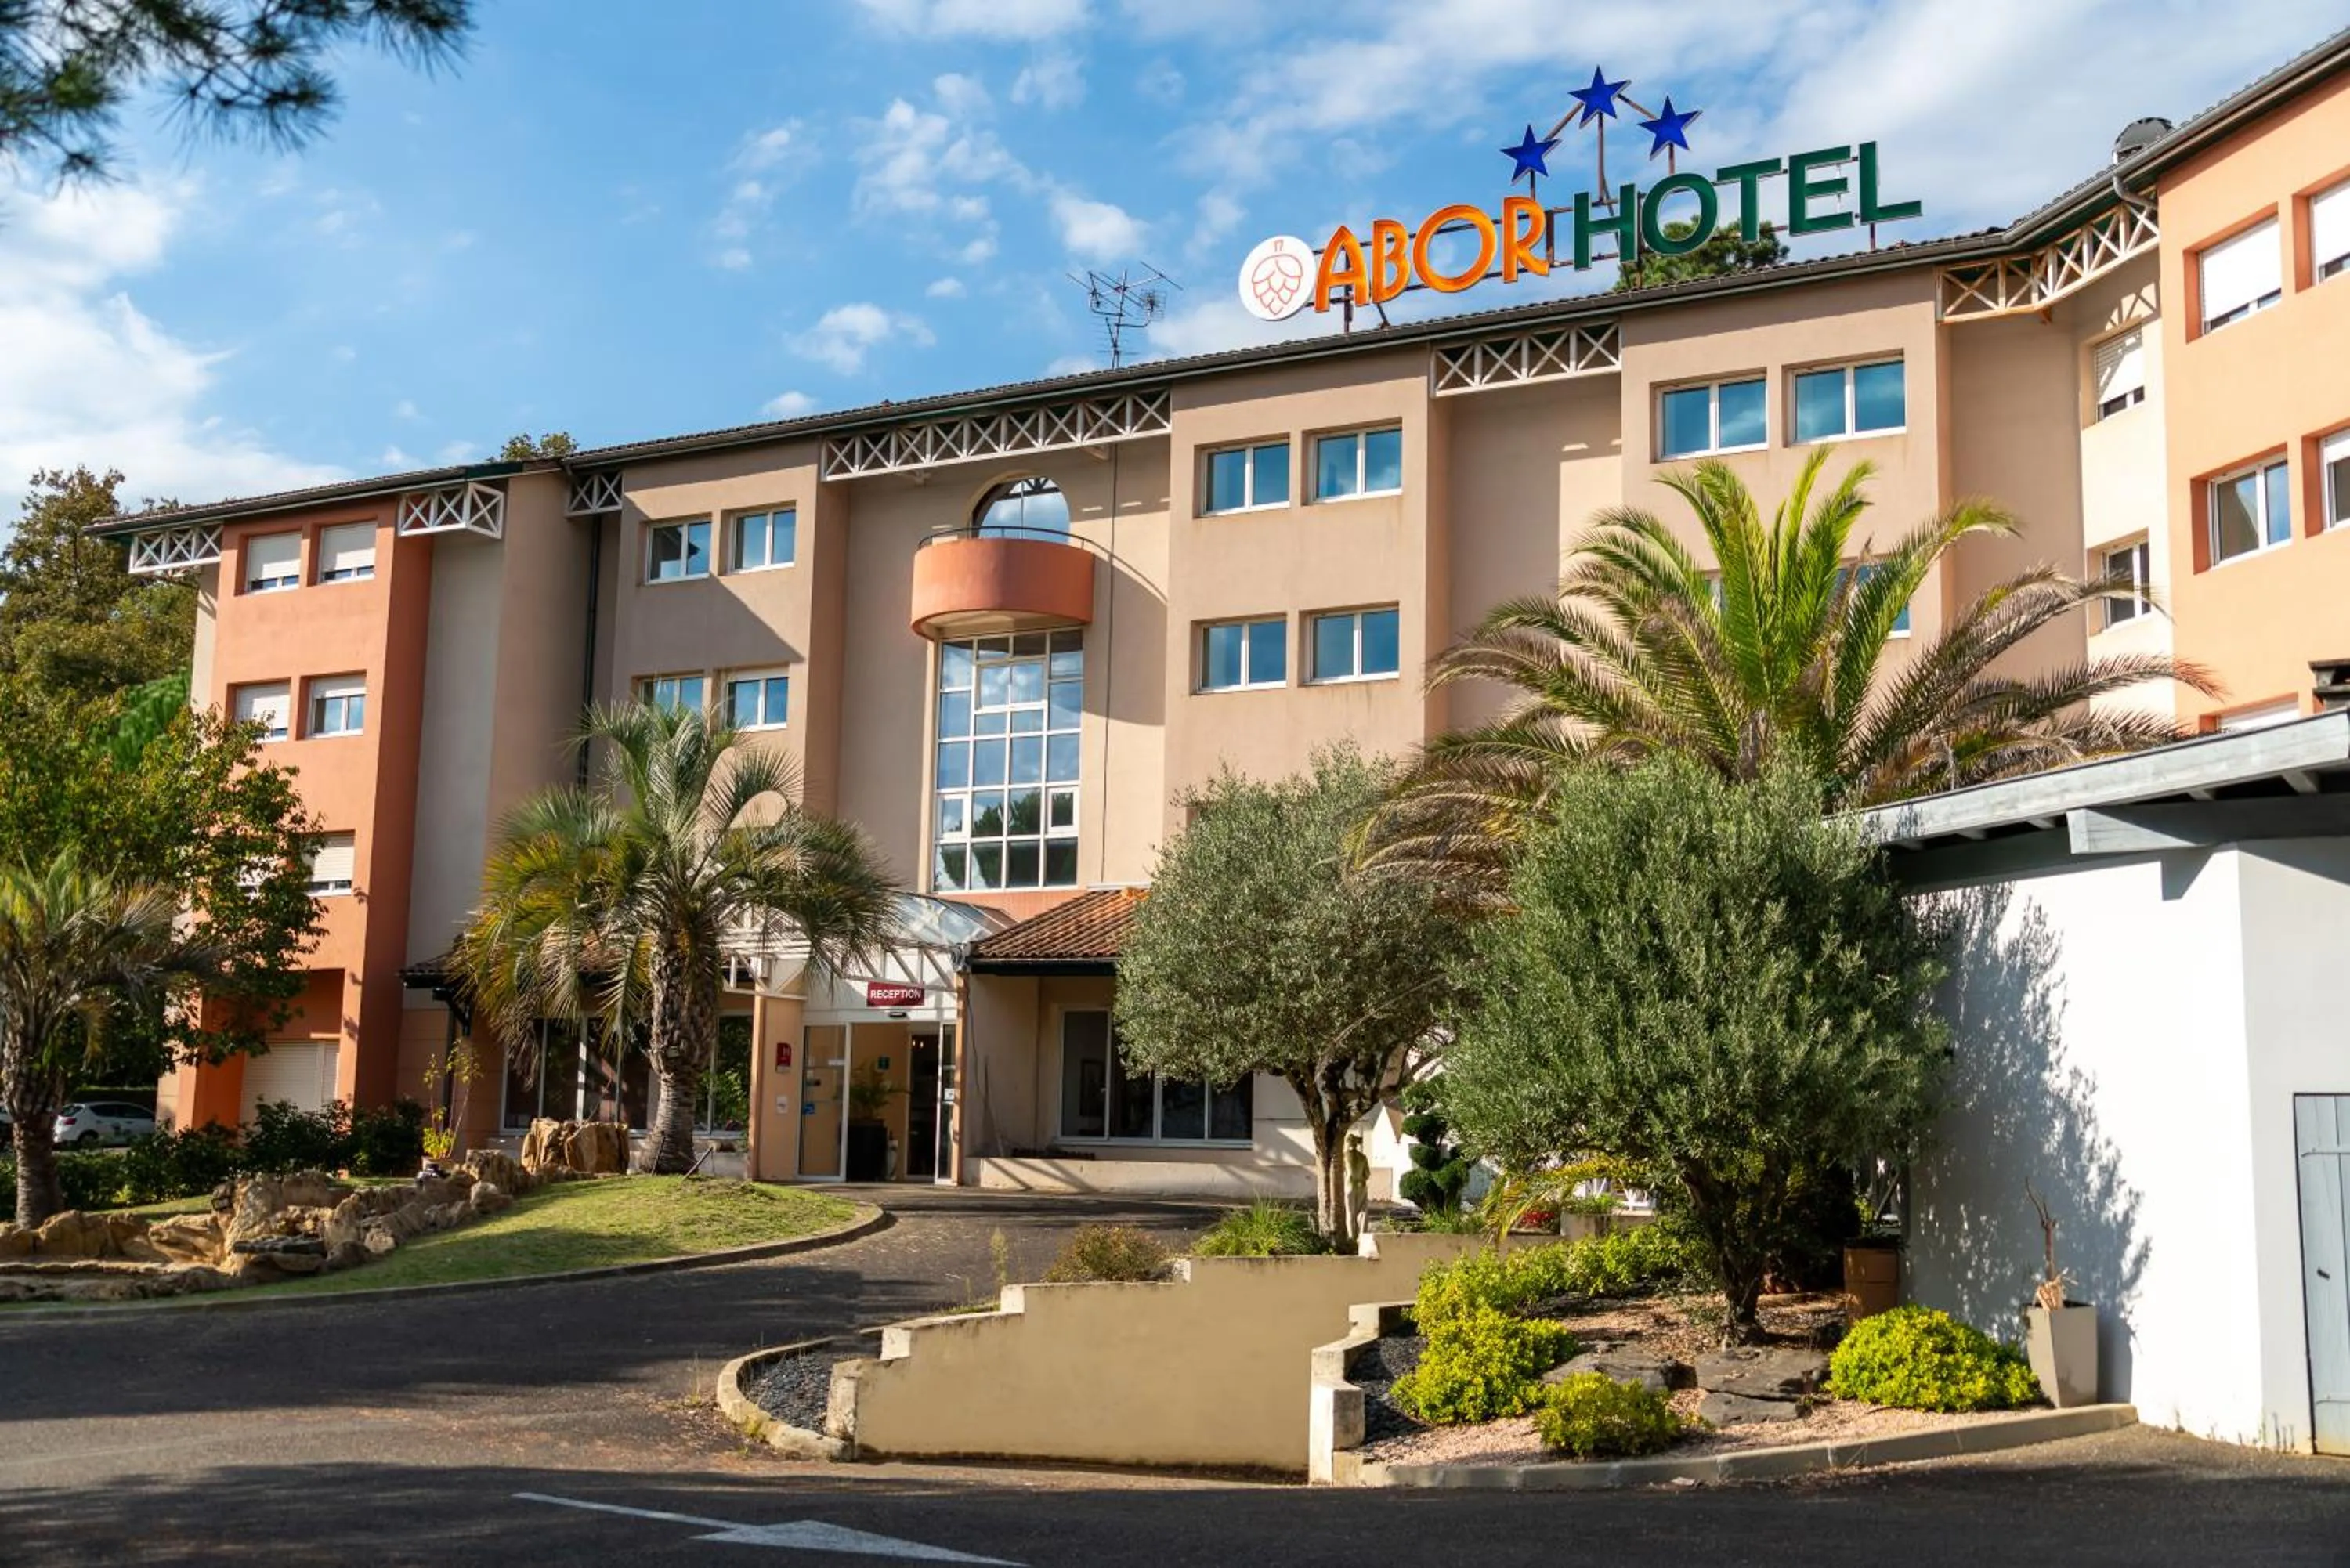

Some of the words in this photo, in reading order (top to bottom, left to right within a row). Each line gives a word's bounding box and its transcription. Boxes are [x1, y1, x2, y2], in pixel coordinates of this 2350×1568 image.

[1314, 196, 1549, 313] ABOR
[1573, 140, 1922, 271] HOTEL
[870, 988, 921, 999] RECEPTION
